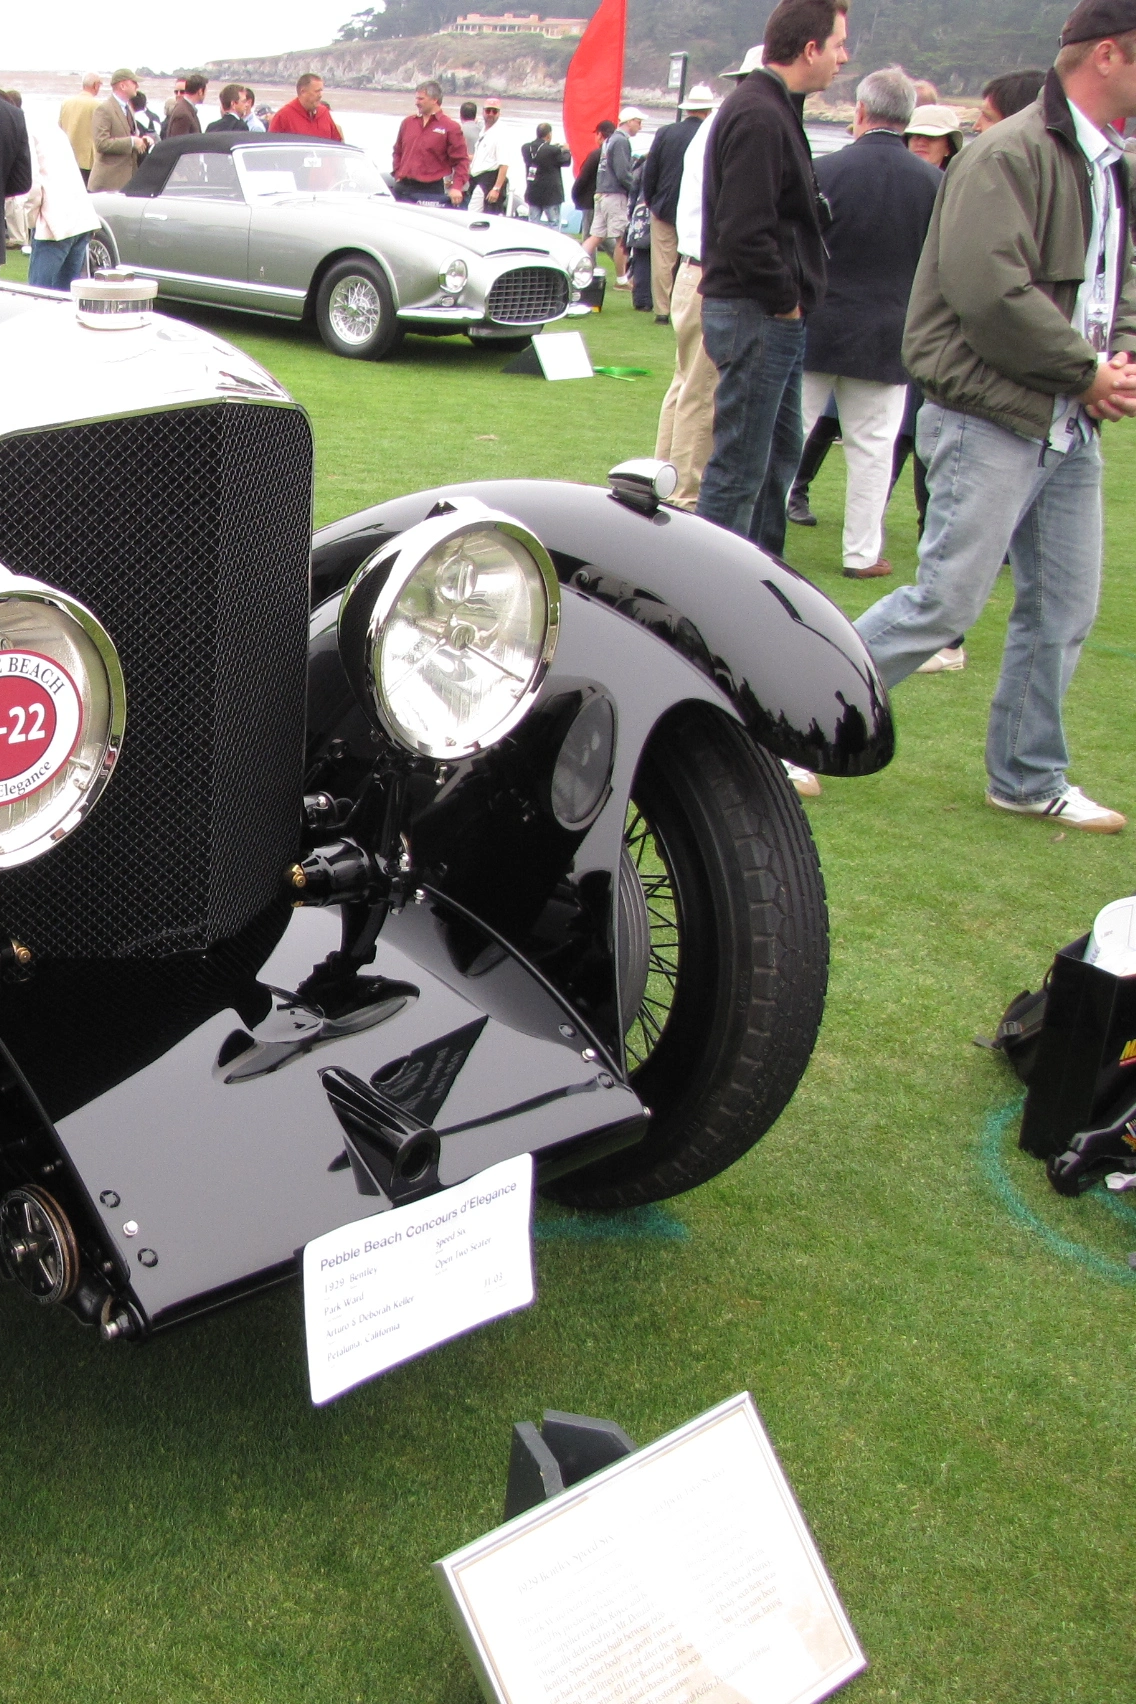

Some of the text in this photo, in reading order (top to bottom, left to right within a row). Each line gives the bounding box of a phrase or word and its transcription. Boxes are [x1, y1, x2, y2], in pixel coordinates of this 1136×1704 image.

[8, 657, 66, 696] BEACH
[320, 1181, 517, 1271] Pebble Beach Concours d'Elegance
[435, 1230, 455, 1249] Speed
[435, 1255, 453, 1269] Open
[455, 1247, 469, 1258] Two
[470, 1236, 492, 1251] Seater
[324, 1266, 377, 1293] 1929 Bentley
[324, 1291, 364, 1316] Park Ward
[326, 1323, 350, 1339] Arturo
[359, 1303, 391, 1323] Deborah
[364, 1323, 401, 1343] California
[542, 1674, 570, 1692] Bentley
[567, 1658, 589, 1677] Speed
[587, 1648, 607, 1664] Sixes
[606, 1637, 624, 1652] built
[622, 1621, 651, 1642] between
[559, 1684, 574, 1698] had
[573, 1678, 587, 1690] one
[586, 1666, 605, 1682] other
[632, 1636, 653, 1652] sporty
[583, 1685, 598, 1700] and
[596, 1673, 615, 1691] fitted
[615, 1671, 624, 1679] to
[629, 1657, 642, 1673] just
[642, 1648, 658, 1662] after
[657, 1640, 670, 1652] the
[622, 1677, 640, 1691] Litre
[638, 1661, 666, 1680] Bentley
[663, 1654, 676, 1664] for
[674, 1647, 686, 1657] the
[645, 1674, 669, 1693] chassis
[668, 1663, 682, 1677] and
